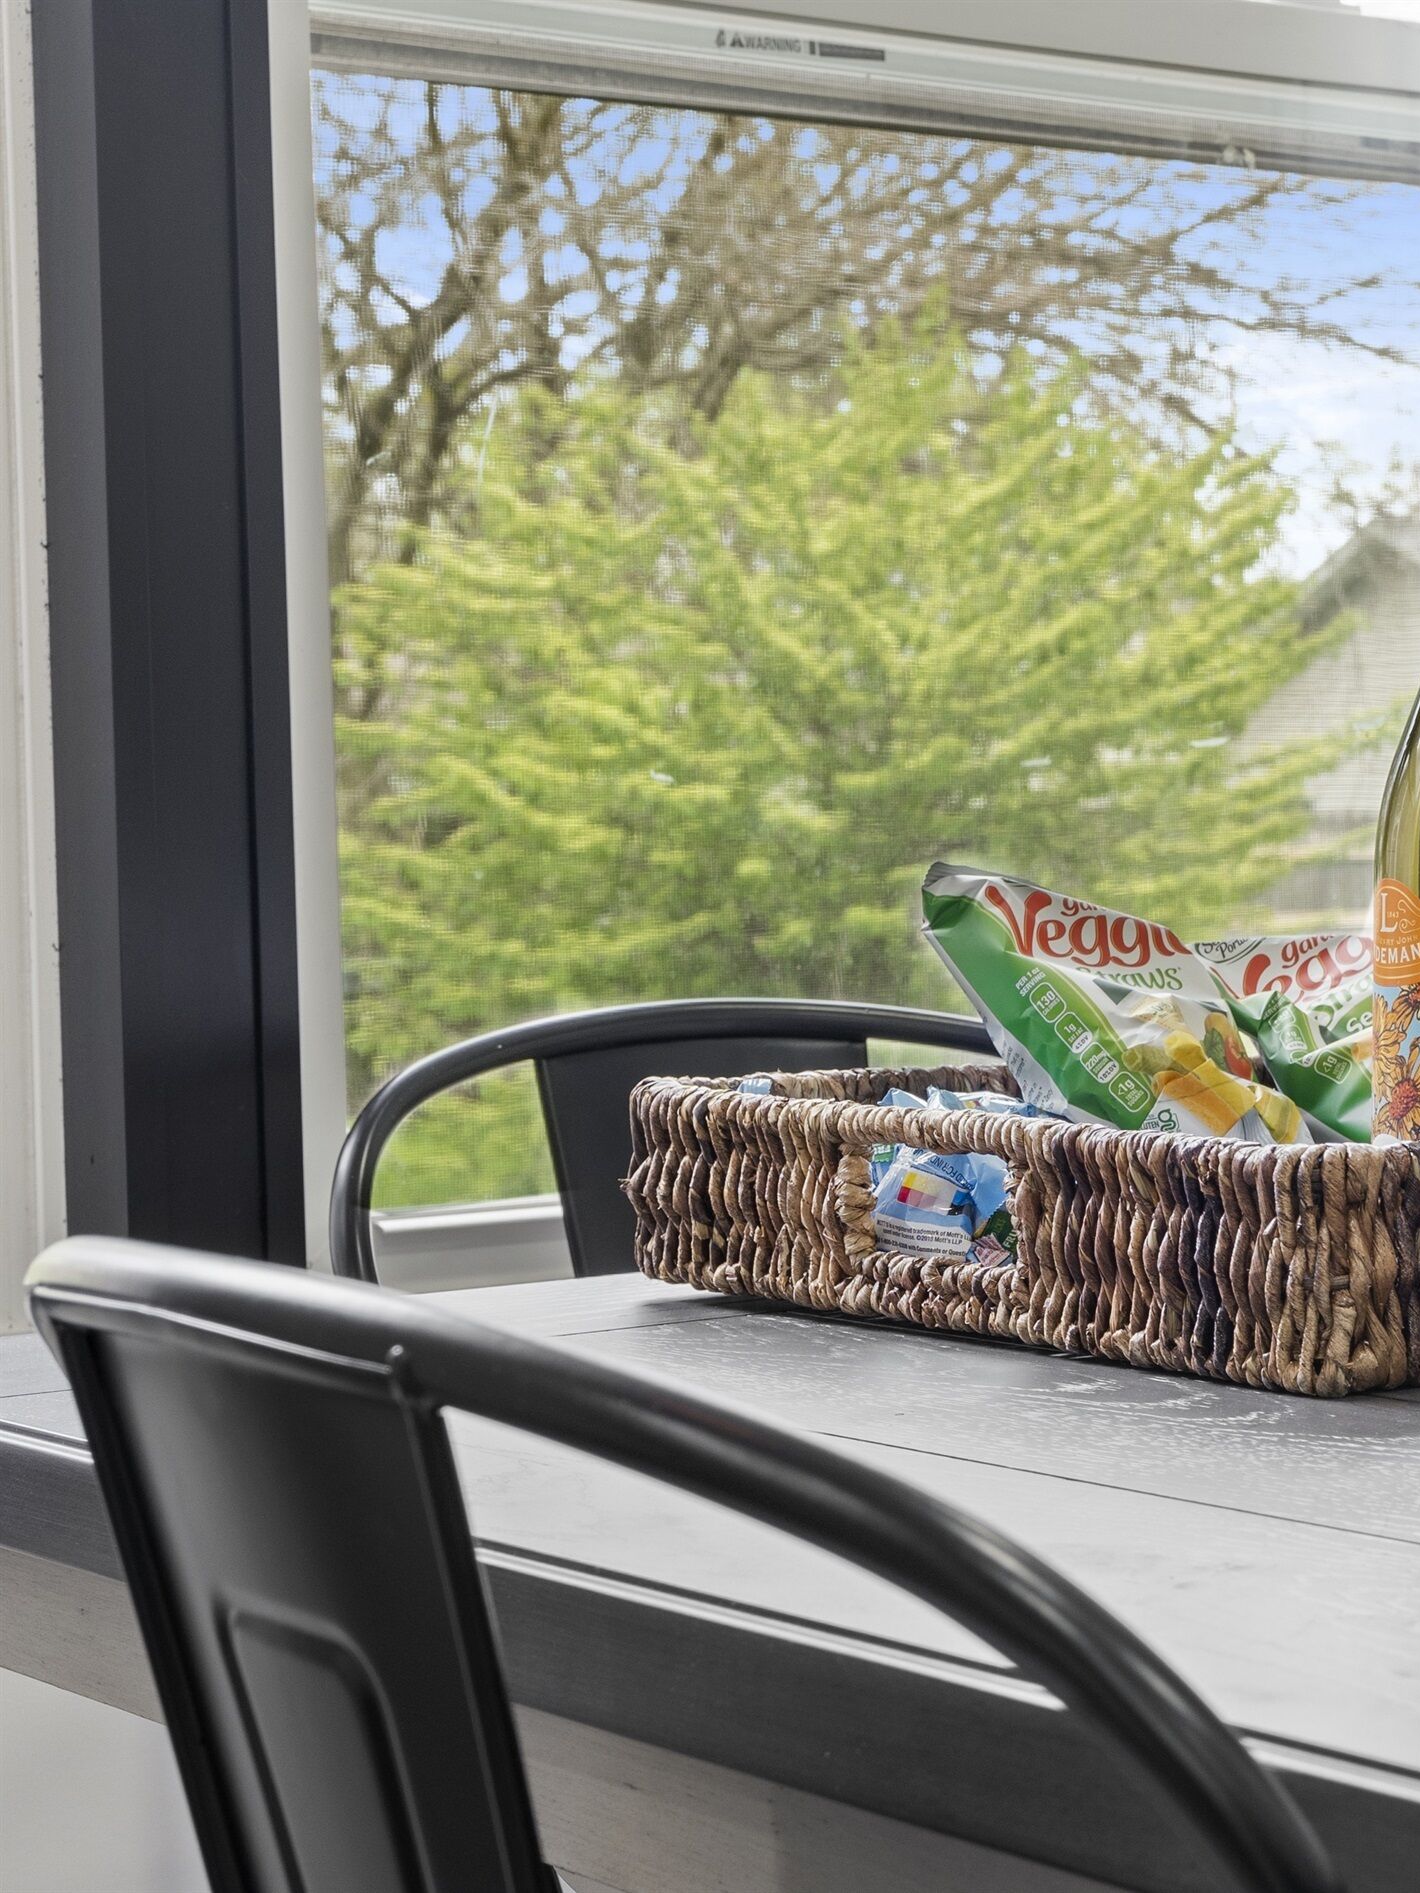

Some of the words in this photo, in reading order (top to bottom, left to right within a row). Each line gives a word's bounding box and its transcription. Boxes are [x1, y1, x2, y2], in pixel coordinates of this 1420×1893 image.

[744, 35, 801, 53] WARNING
[1380, 892, 1399, 933] L
[985, 884, 1193, 968] Veggi
[1036, 990, 1056, 1010] 130
[1063, 1023, 1077, 1034] 1g
[934, 1236, 951, 1244] Mott's
